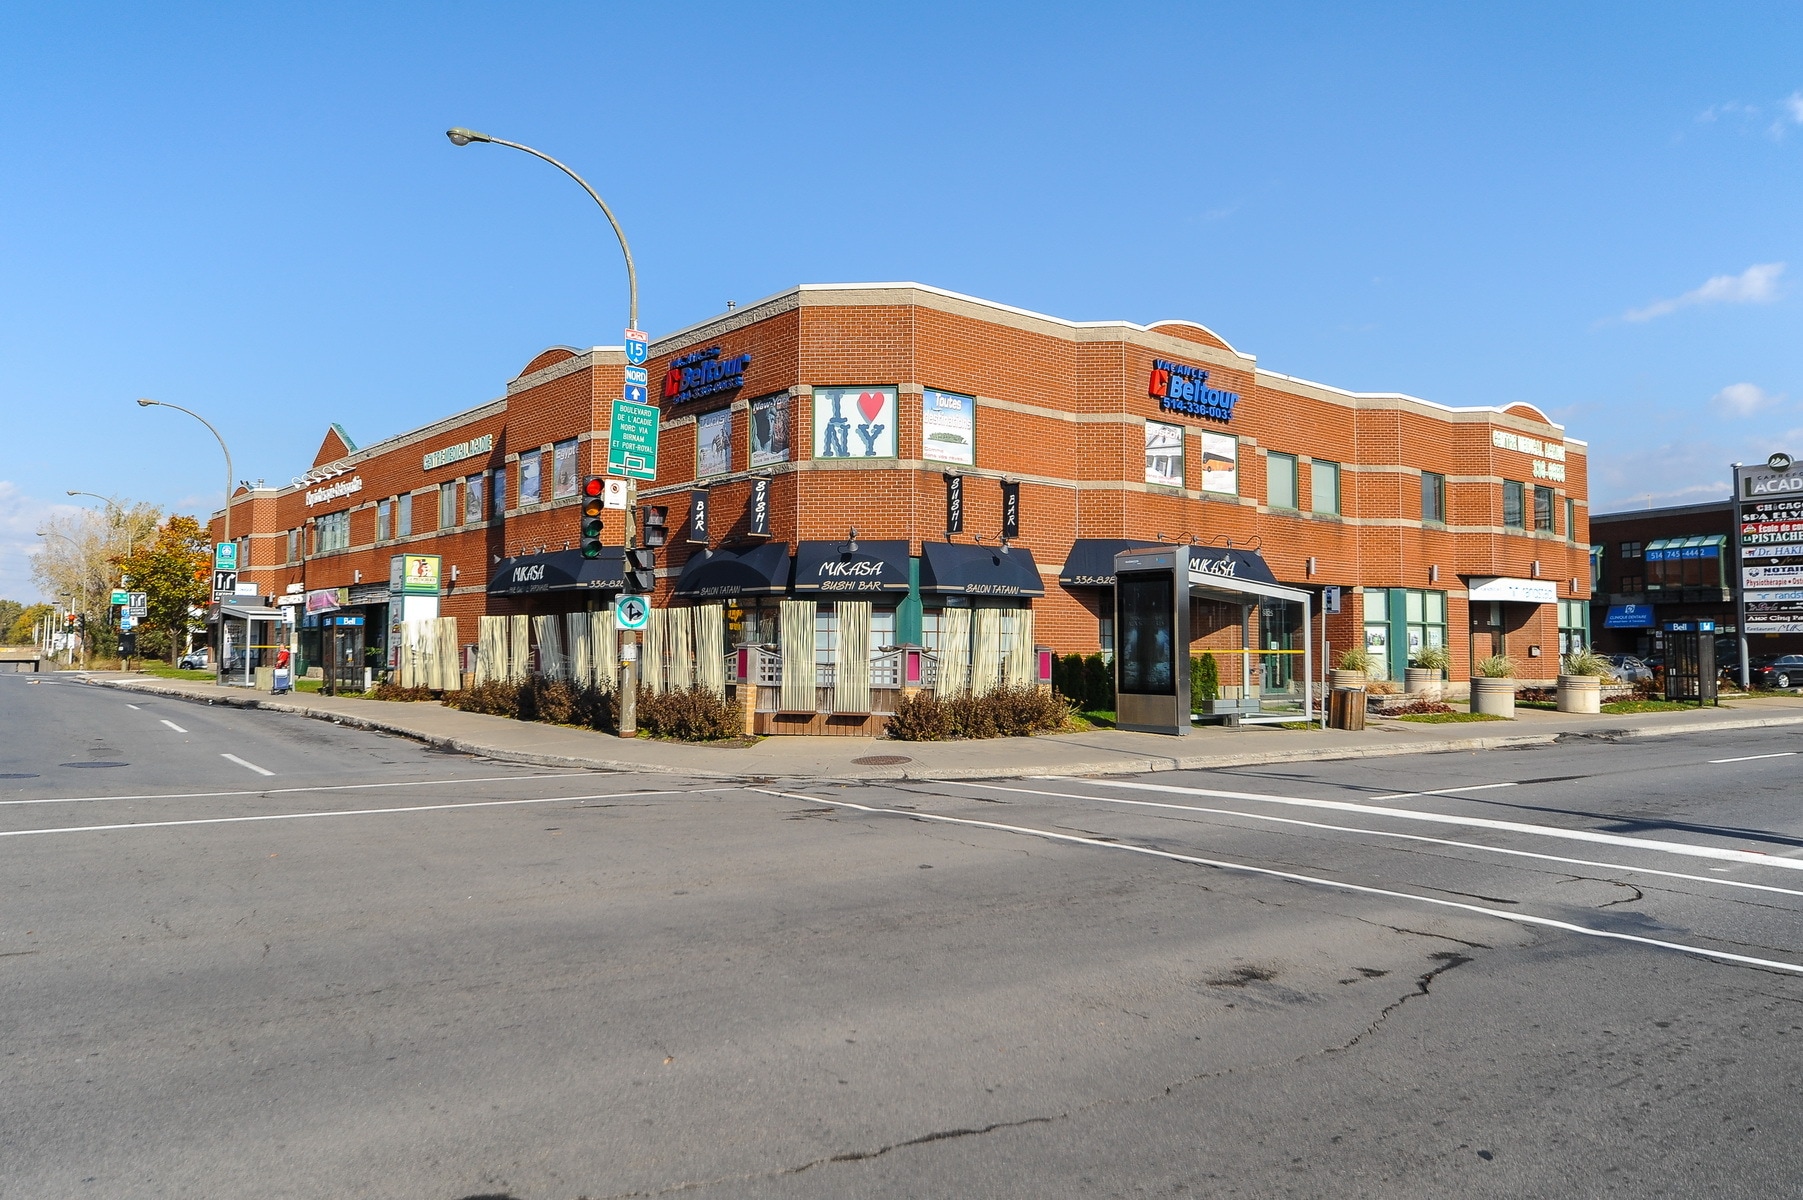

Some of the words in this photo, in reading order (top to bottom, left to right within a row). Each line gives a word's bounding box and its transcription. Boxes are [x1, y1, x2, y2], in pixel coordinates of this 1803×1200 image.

[630, 342, 643, 356] 15
[626, 370, 646, 382] NORD
[680, 353, 752, 391] Beltour
[1156, 360, 1210, 379] VACANCES
[1170, 375, 1240, 409] Beltour
[825, 390, 848, 423] I
[935, 392, 962, 410] Toutes
[620, 404, 652, 416] BOULEVARD
[1163, 397, 1234, 420] 514-336-0033
[617, 413, 625, 421] DE
[627, 415, 653, 426] L'ACADIE
[638, 426, 649, 434] VIA
[622, 432, 645, 443] BIRNAM
[621, 441, 654, 454] PORT-ROYAL
[755, 480, 767, 534] SUSHI
[950, 477, 960, 532] SUSHI
[1007, 494, 1016, 526] BAR
[1755, 502, 1803, 512] CHICAG
[695, 500, 705, 532] BAR
[1742, 513, 1769, 522] SPA
[1780, 524, 1791, 532] de
[1758, 548, 1772, 556] Dr.
[512, 564, 546, 583] MIKASA
[818, 561, 884, 576] MIKASA
[1188, 557, 1237, 577] MIKASA
[700, 586, 719, 596] SALON
[821, 580, 856, 591] SUSHI
[857, 580, 882, 592] BAR
[966, 583, 992, 594] SALON
[343, 617, 356, 625] Bell
[1769, 614, 1791, 622] Cinq
[1672, 622, 1688, 631] Bell
